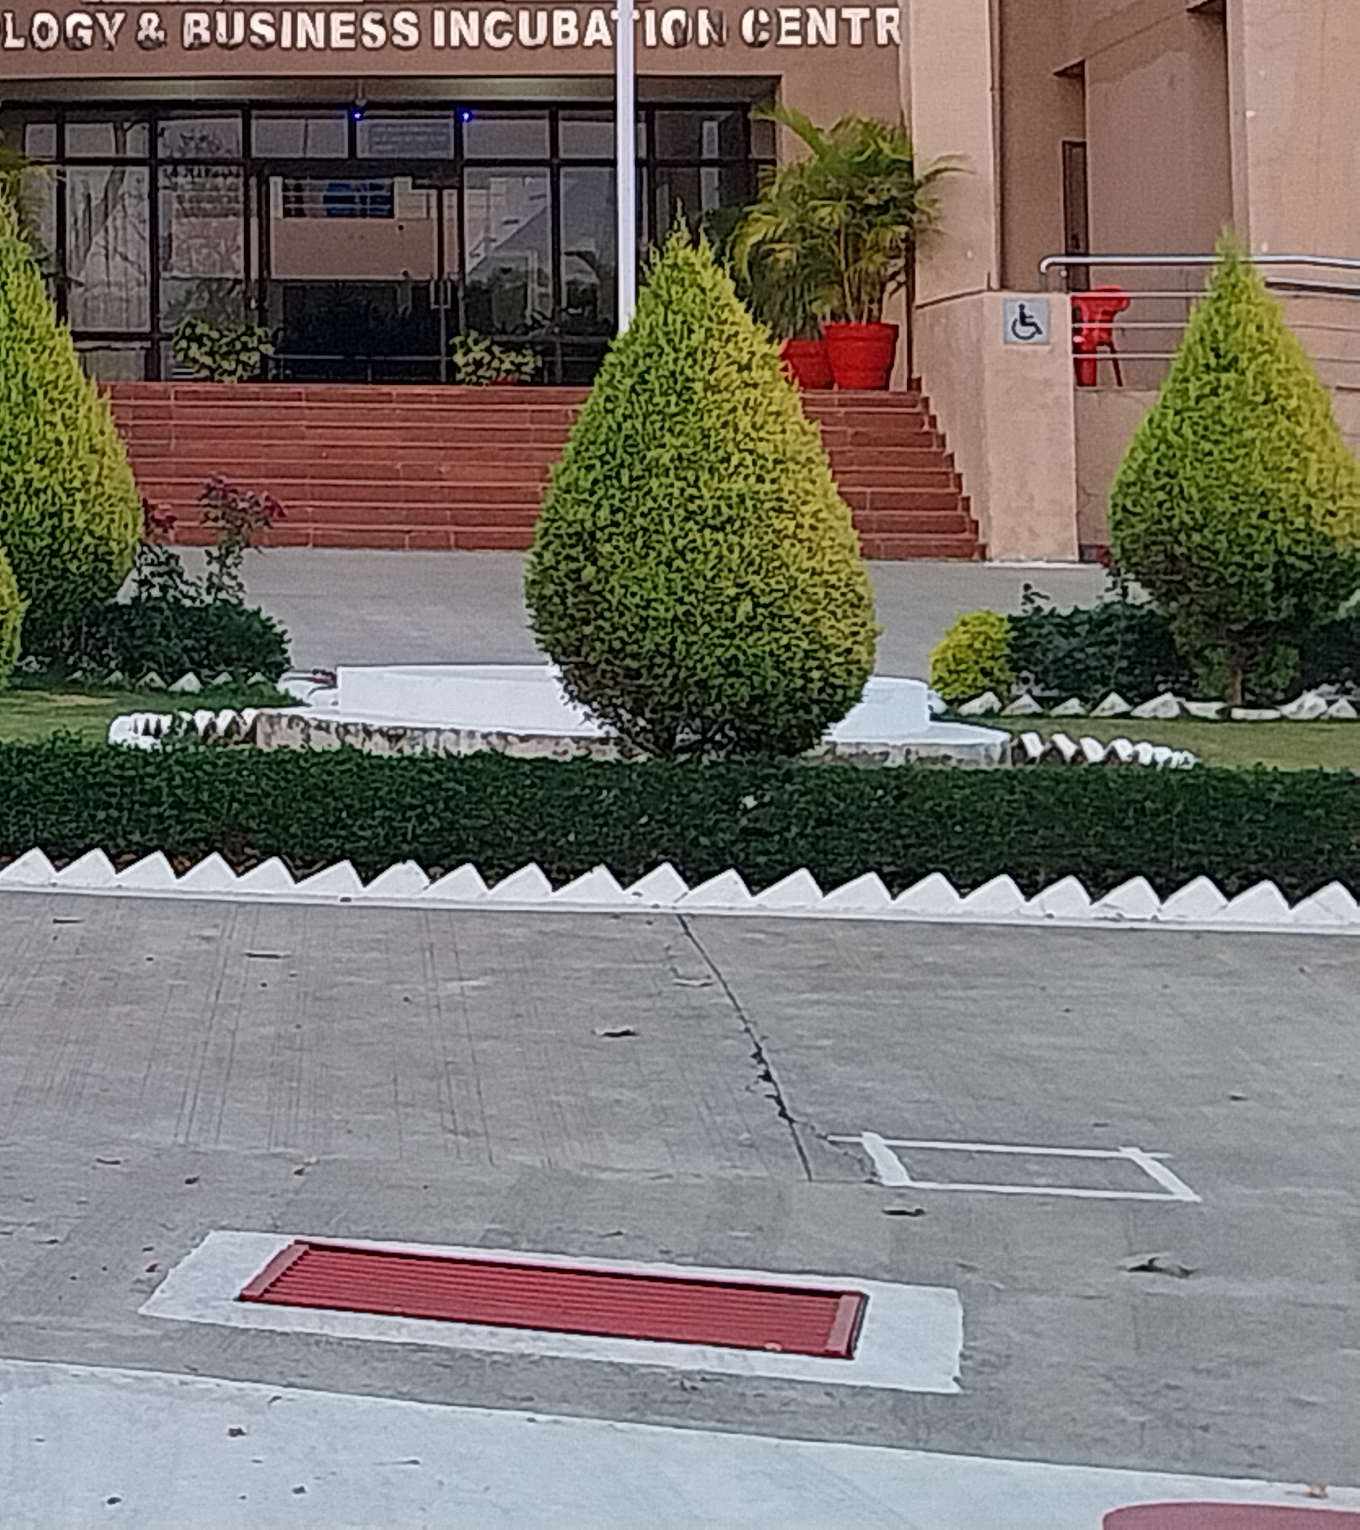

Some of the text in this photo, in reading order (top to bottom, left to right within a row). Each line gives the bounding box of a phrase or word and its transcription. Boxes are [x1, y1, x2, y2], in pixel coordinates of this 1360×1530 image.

[136, 11, 167, 50] &
[181, 9, 421, 50] BUSINESS
[432, 8, 728, 49] INCUBAION
